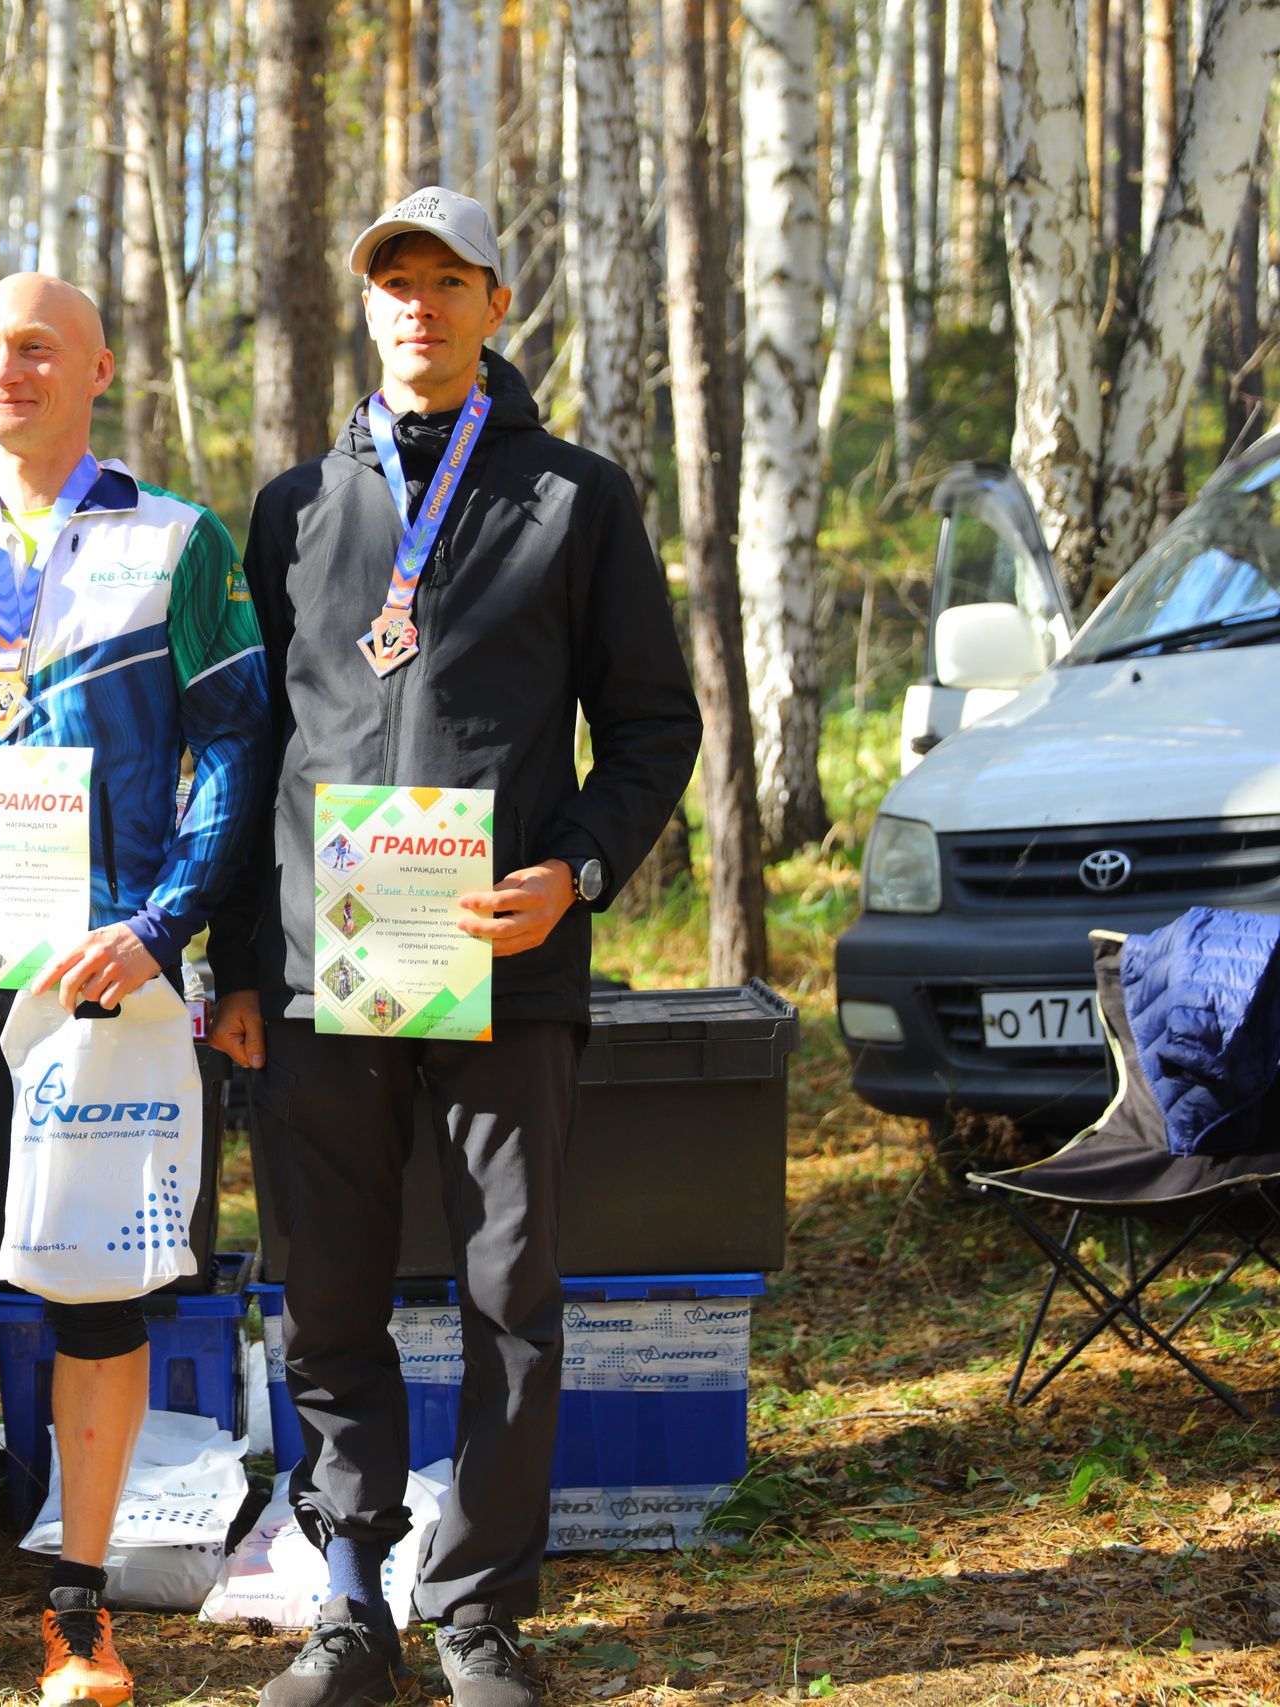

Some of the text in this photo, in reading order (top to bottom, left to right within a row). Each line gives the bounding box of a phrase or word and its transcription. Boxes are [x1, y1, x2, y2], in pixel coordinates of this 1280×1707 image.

[402, 211, 447, 220] TRAILS
[426, 421, 475, 520] ГОРНЫЙ КОРОЛЬ
[90, 571, 170, 582] EKB-O-TEAM
[401, 628, 417, 647] 3
[6, 822, 57, 830] НАГРАЖДАЕТСЯ
[369, 835, 487, 858] ГРАМОТА
[400, 866, 457, 875] НАГРАЖДАЕТСЯ
[392, 918, 438, 926] традиционных
[192, 1016, 201, 1036] 1
[53, 1102, 180, 1123] NORD
[18, 1129, 179, 1143] УНКНАЛЬНАЯ СПОРТИВНАЯ ОДЕЖДА
[11, 1243, 78, 1253] wntesport45.ru
[708, 1308, 750, 1320] NOR
[577, 1319, 632, 1328] NORD
[407, 1354, 463, 1362] NORD
[660, 1351, 718, 1359] NORD
[562, 1357, 586, 1365] RD
[632, 1375, 689, 1383] NORD
[550, 1503, 593, 1514] RD
[588, 1527, 673, 1539] NORD
[224, 1592, 285, 1601] wintersport45.ru
